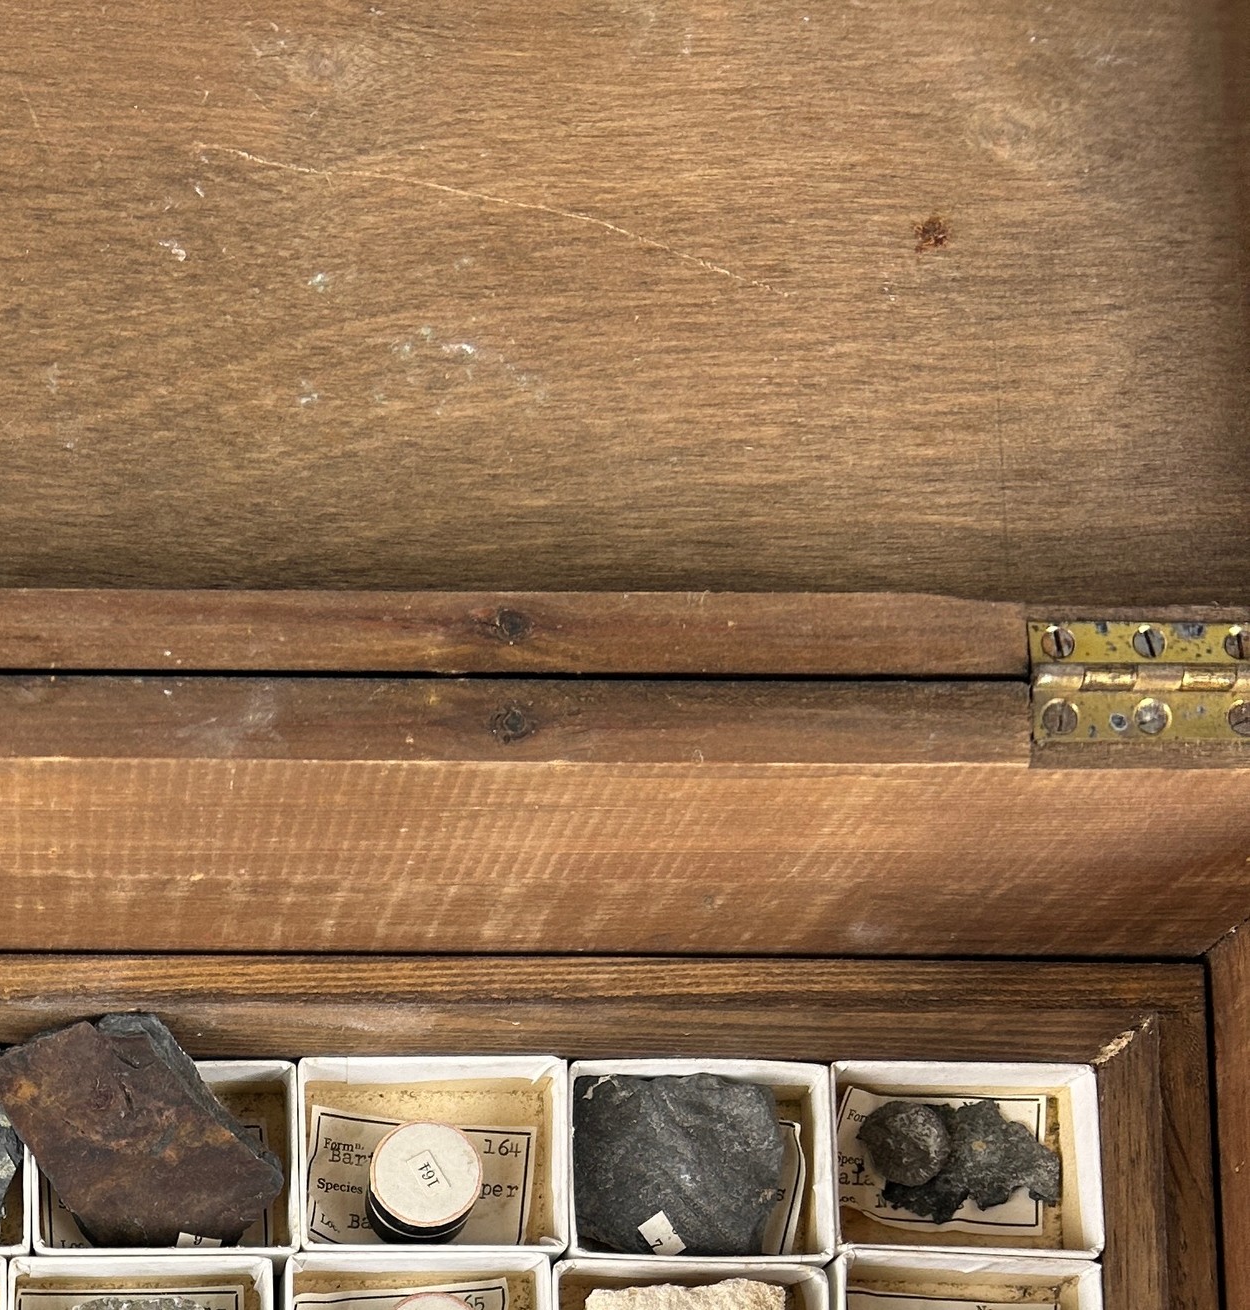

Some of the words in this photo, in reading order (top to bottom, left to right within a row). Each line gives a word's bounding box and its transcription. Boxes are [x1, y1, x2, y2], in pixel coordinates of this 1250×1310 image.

[482, 1138, 522, 1158] 164
[417, 1161, 440, 1188] 164
[316, 1177, 363, 1194] Species
